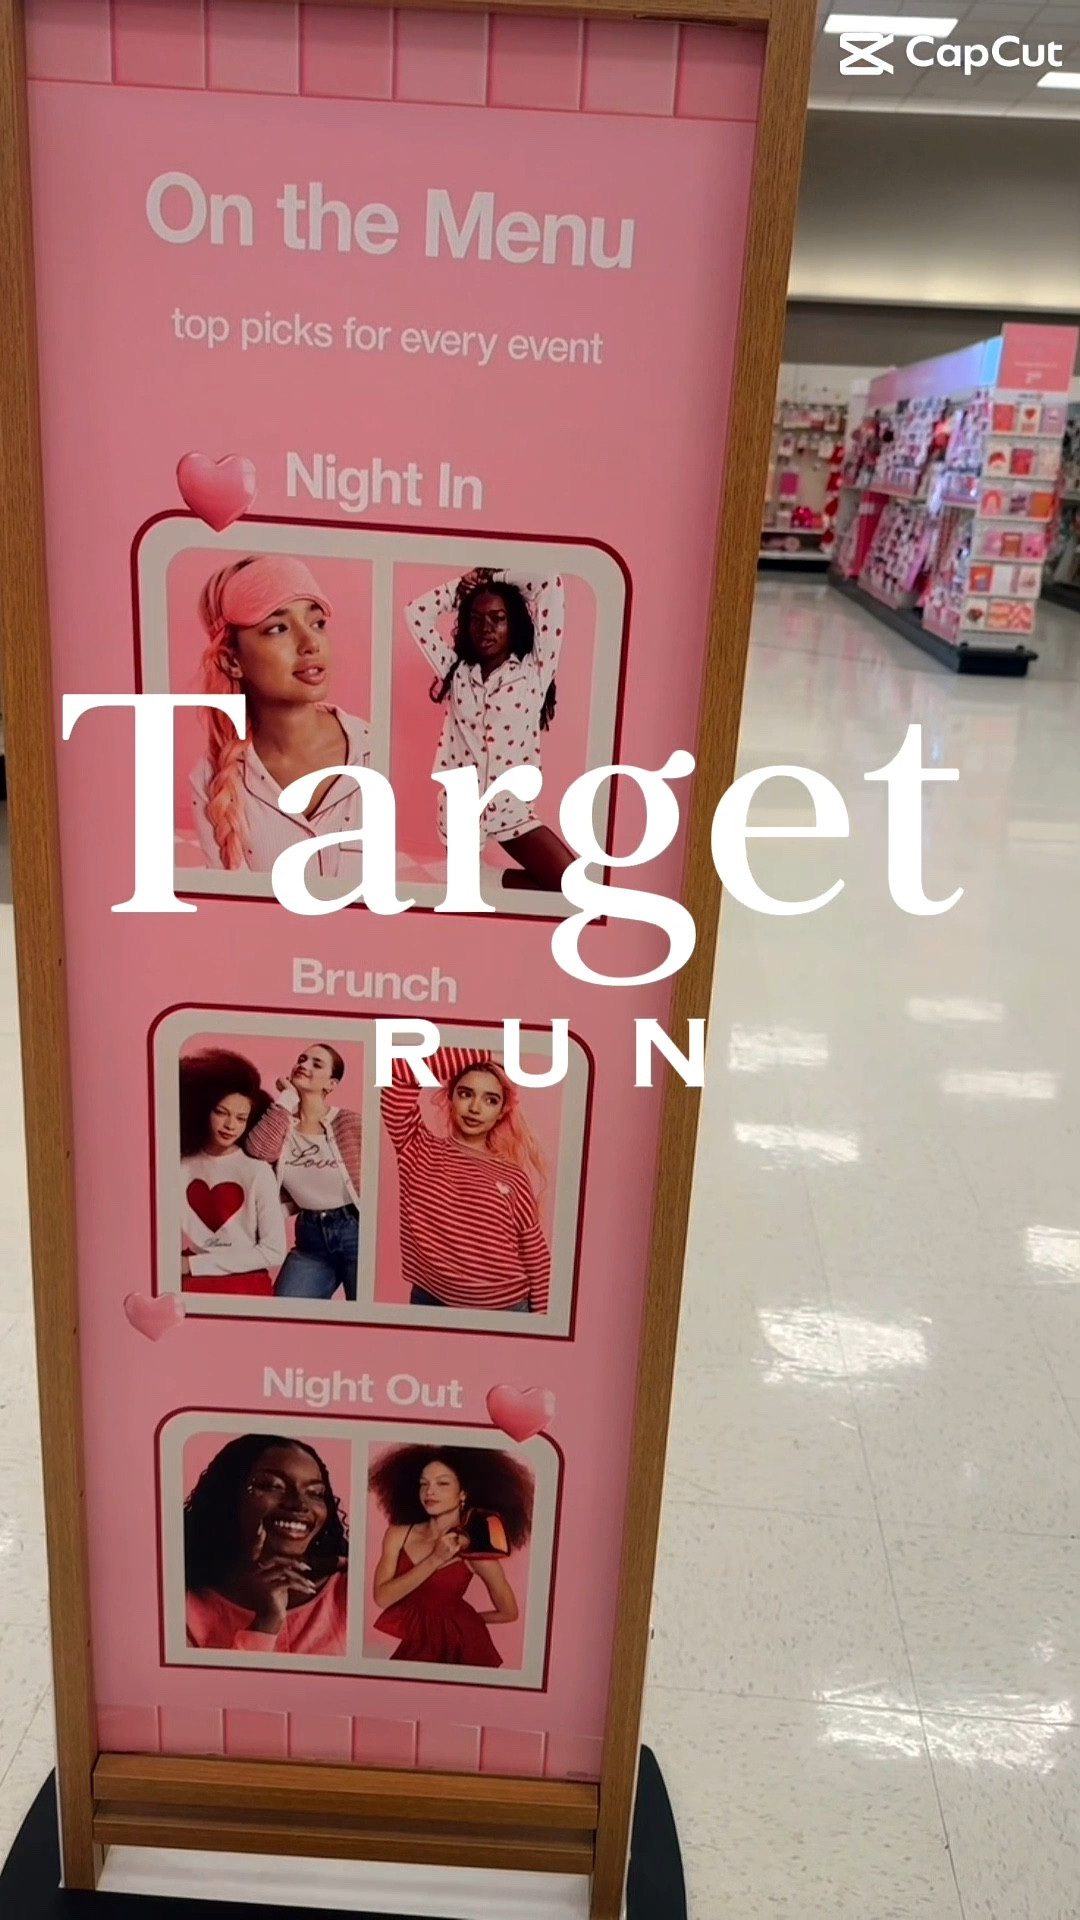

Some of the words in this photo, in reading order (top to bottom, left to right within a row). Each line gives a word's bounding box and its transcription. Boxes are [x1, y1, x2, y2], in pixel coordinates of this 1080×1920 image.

[146, 171, 254, 247] On
[277, 182, 400, 256] the
[425, 188, 636, 270] Menu
[172, 308, 230, 349] top
[241, 311, 334, 351] picks
[343, 316, 392, 352] for
[400, 328, 499, 367] every
[507, 332, 604, 365] event
[286, 451, 424, 514] Night
[438, 462, 485, 511] In
[292, 957, 459, 1004] Brunch
[285, 1144, 340, 1169] Love
[262, 1366, 375, 1408] Night
[386, 1373, 463, 1408] Out
